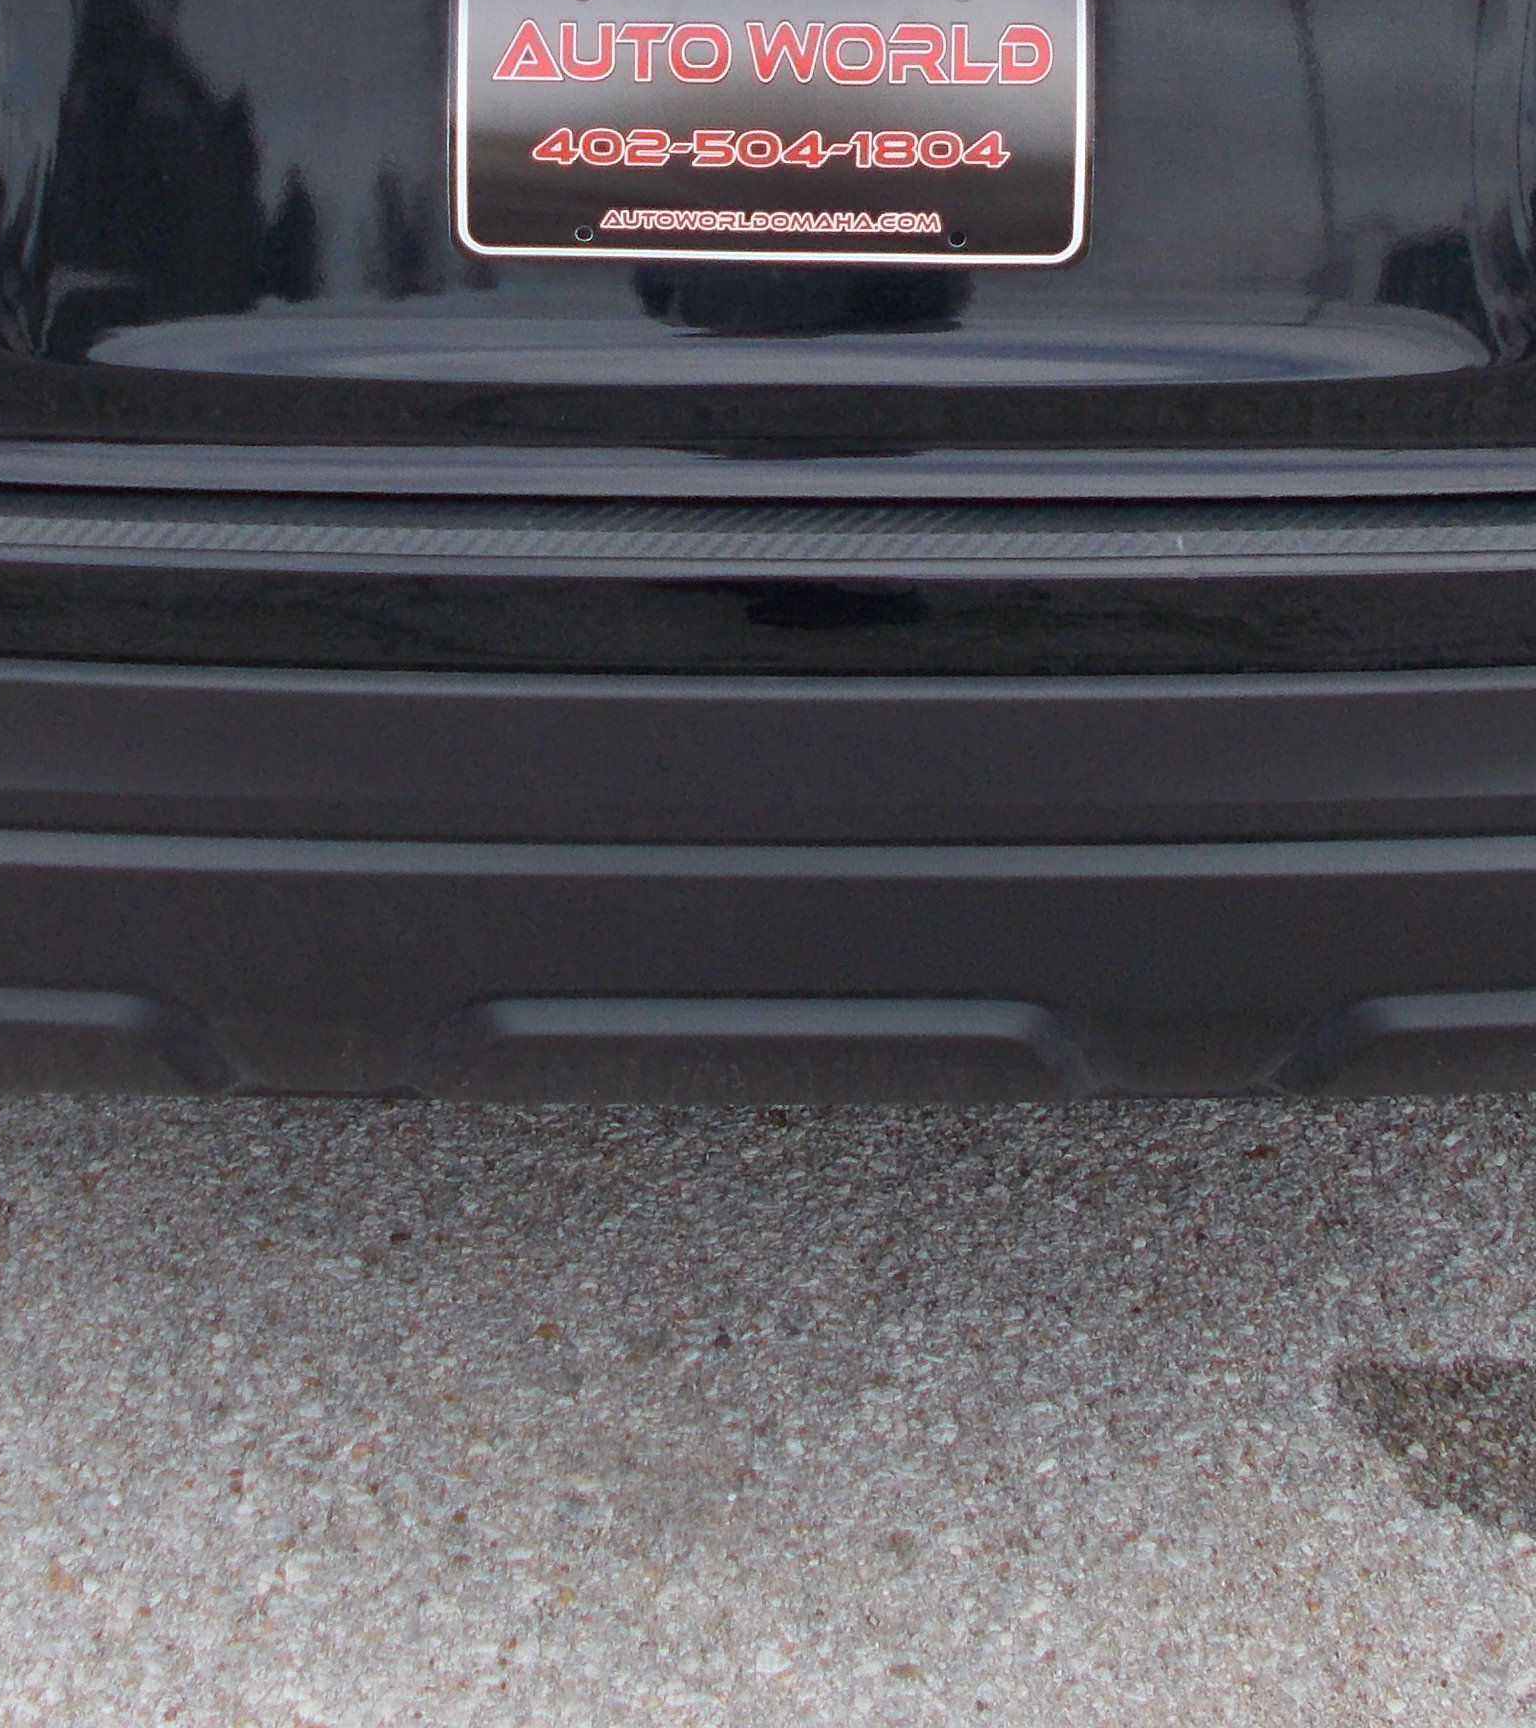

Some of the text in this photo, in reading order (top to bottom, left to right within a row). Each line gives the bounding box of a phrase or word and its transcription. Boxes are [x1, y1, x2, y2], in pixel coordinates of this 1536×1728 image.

[492, 19, 1054, 86] AUTO WORLD
[532, 127, 1012, 169] 402-504-1804
[600, 208, 942, 234] AUTOWORLDOMAHA.COM
